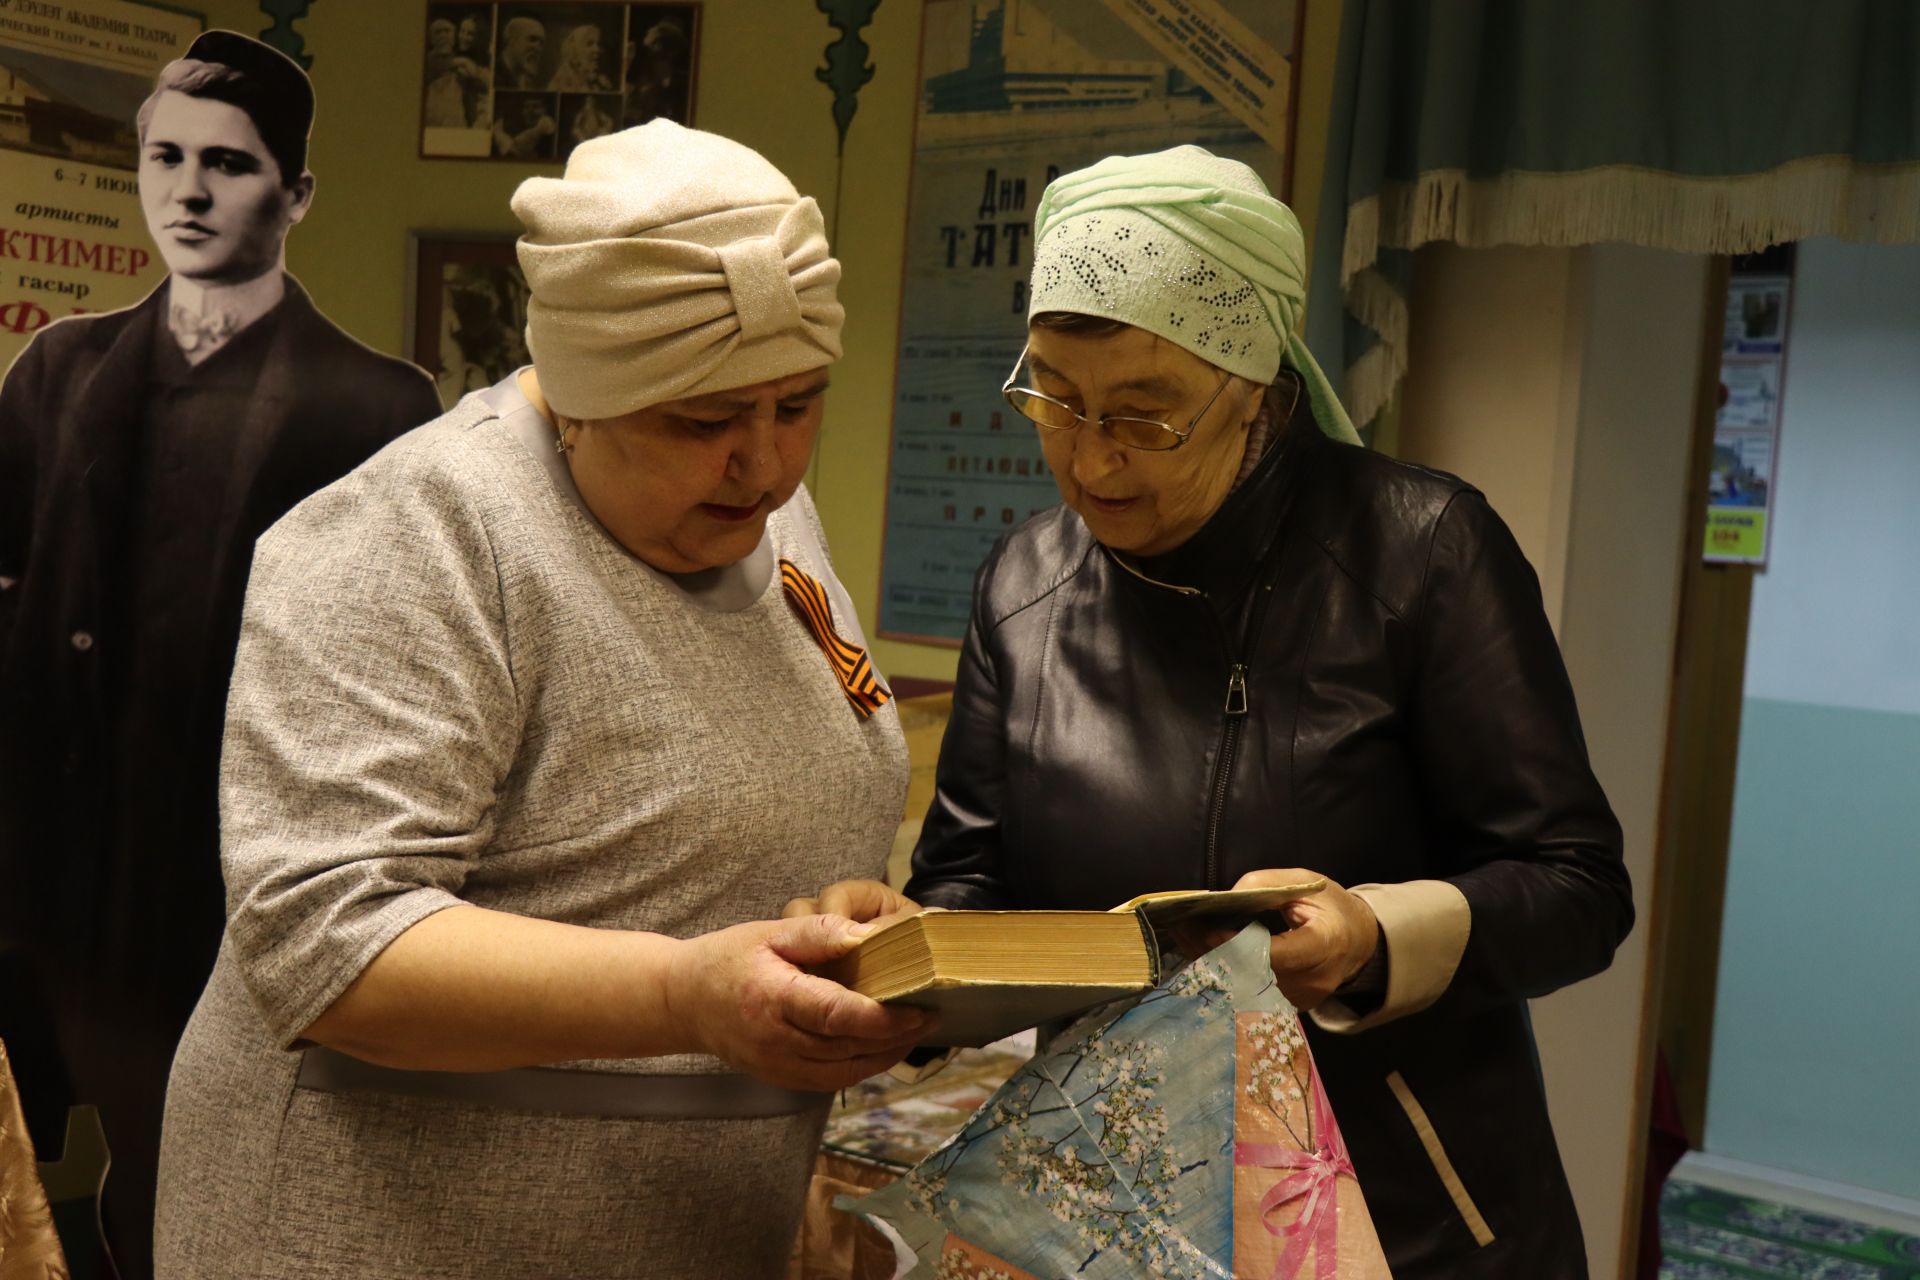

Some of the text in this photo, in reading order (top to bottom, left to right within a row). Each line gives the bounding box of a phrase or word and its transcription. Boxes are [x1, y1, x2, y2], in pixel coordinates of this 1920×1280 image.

[54, 29, 86, 45] ТЕАТР
[66, 10, 130, 36] АКАДЕМИЯ
[133, 24, 176, 47] ТЕАТРЫ
[15, 201, 120, 229] артисты
[18, 273, 90, 299] гасыр
